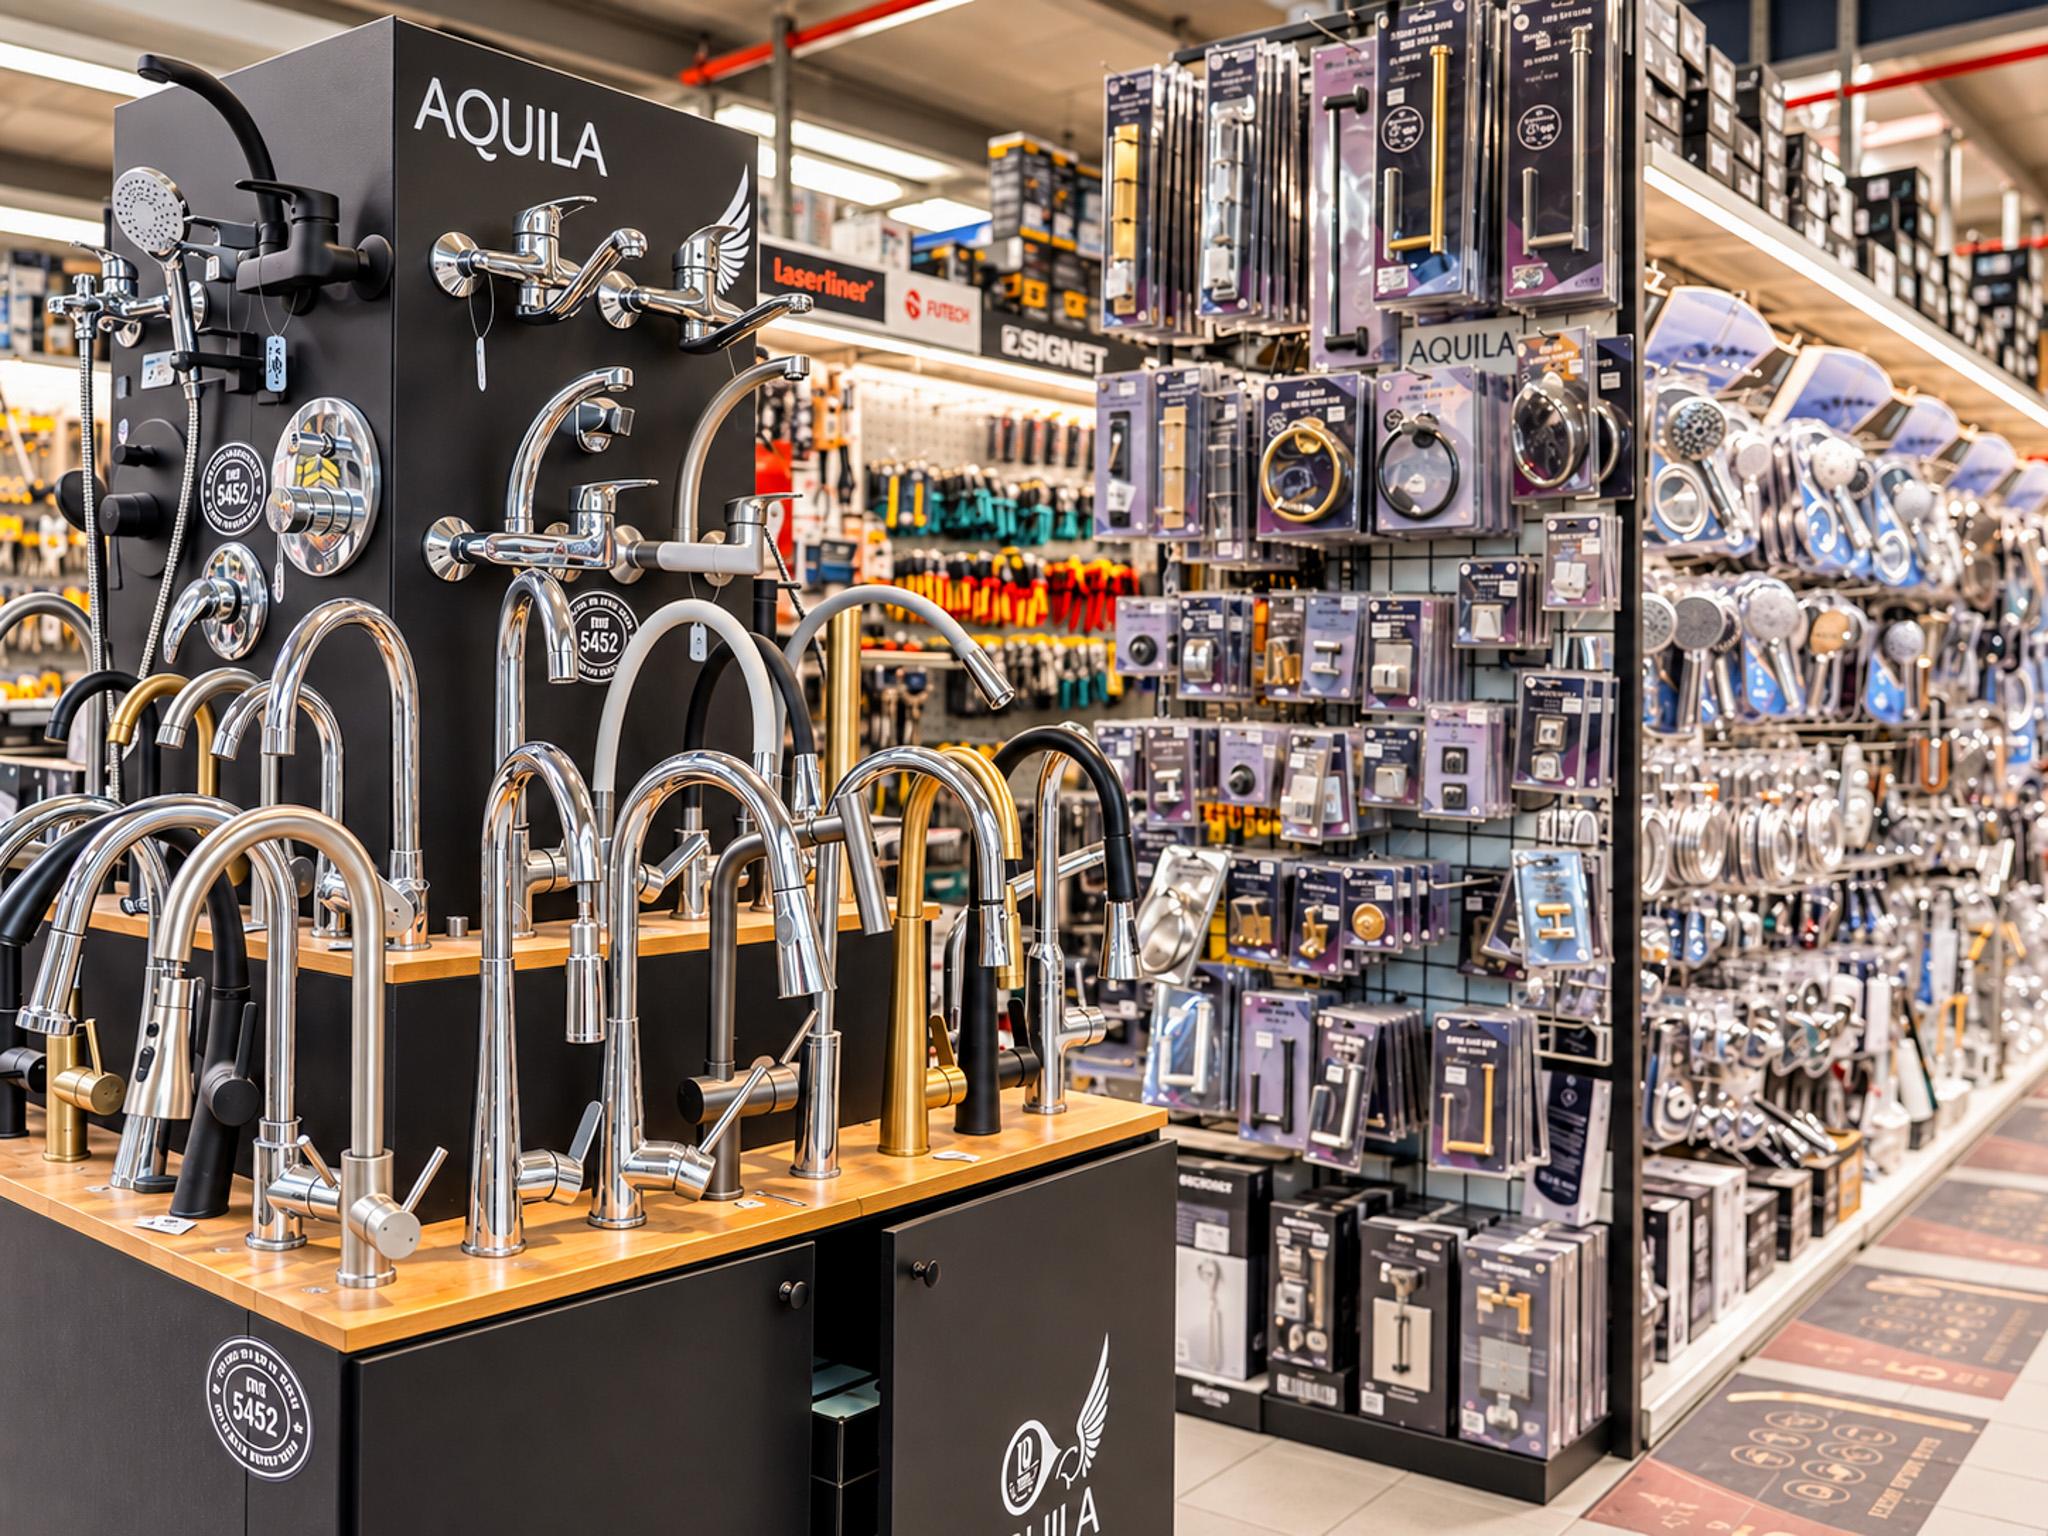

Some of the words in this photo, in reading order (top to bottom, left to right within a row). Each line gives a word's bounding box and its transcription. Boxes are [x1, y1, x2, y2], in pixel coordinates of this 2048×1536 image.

[413, 76, 609, 178] AQUILA
[773, 256, 869, 302] Laserliner
[1020, 329, 1108, 374] SIGNET
[1408, 331, 1515, 365] AQUILA
[217, 482, 248, 506] 5452
[580, 631, 619, 653] 5452
[233, 1391, 278, 1438] 5452
